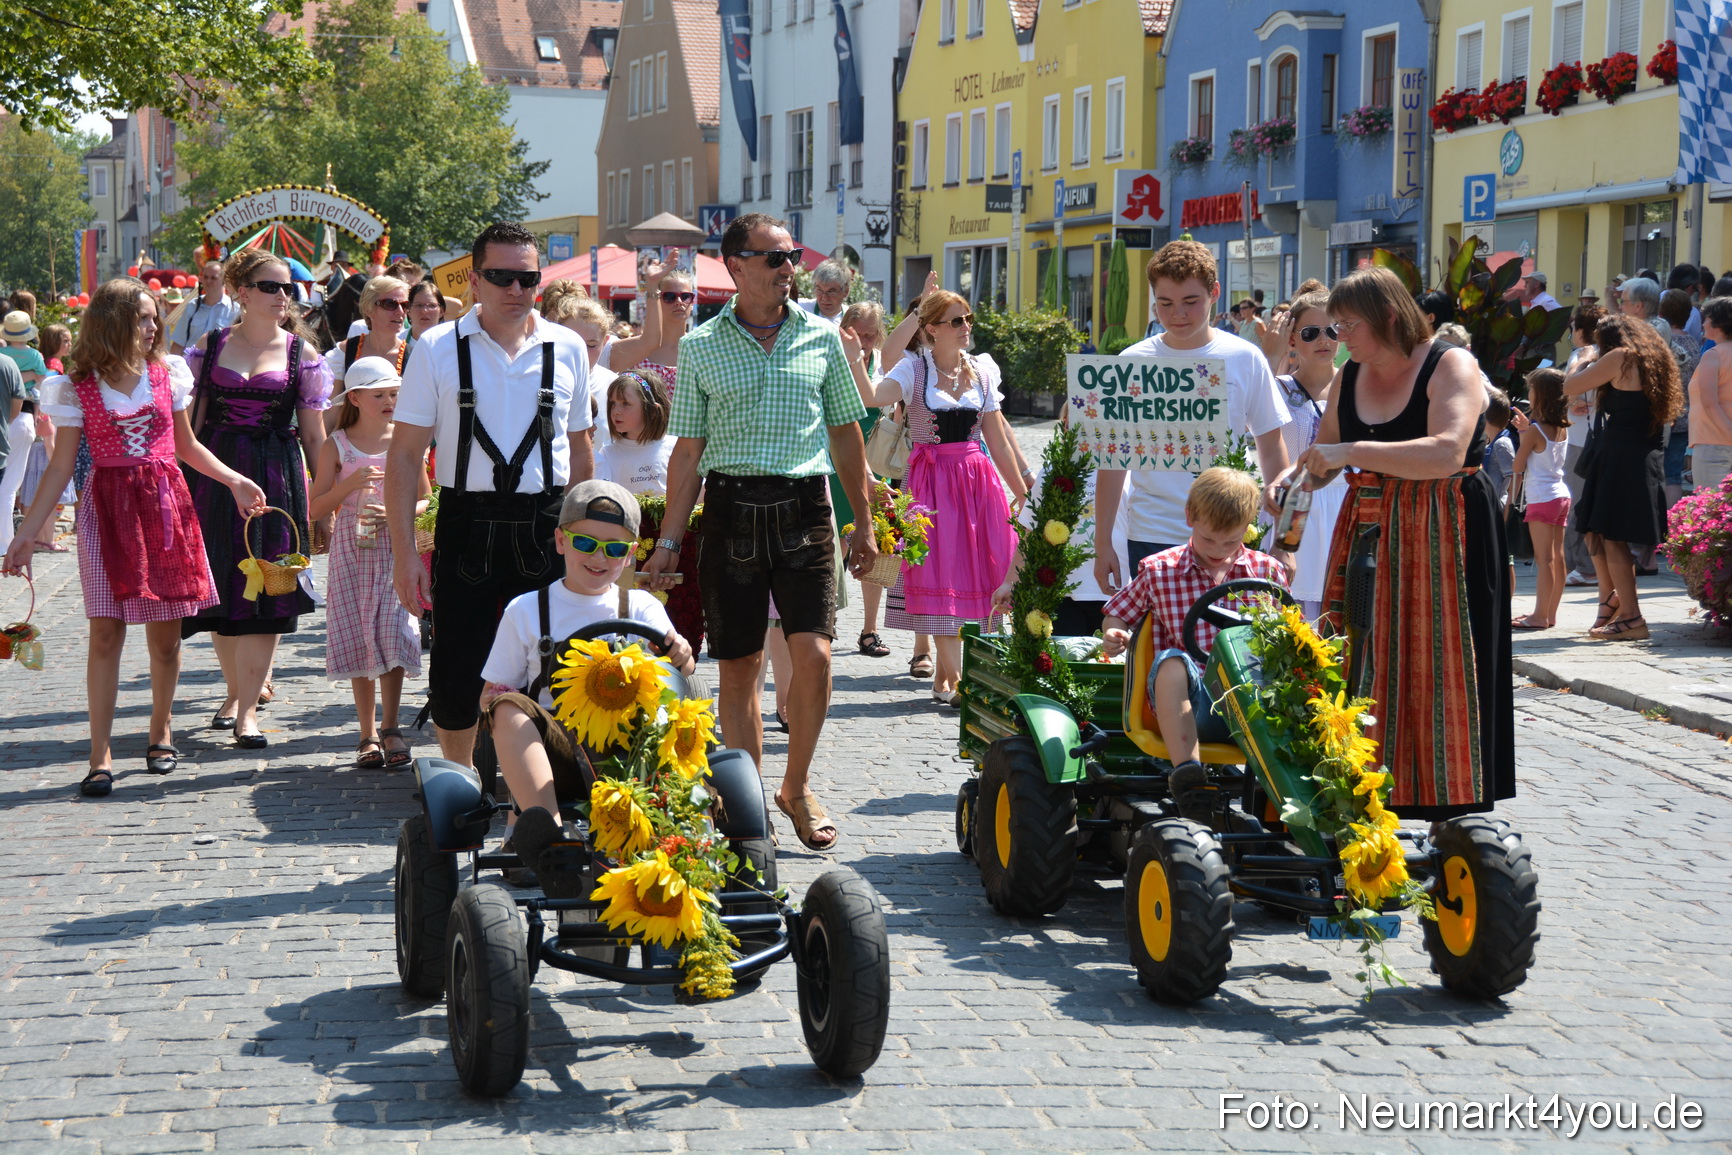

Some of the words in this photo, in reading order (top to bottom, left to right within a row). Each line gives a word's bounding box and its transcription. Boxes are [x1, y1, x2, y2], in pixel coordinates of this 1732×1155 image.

[954, 73, 984, 104] HOTEL
[991, 67, 1025, 93] Lehmeier
[1402, 93, 1420, 187] WITTL
[1013, 157, 1020, 184] P
[988, 201, 1025, 209] TAIF
[1063, 187, 1089, 207] AIFUN
[1470, 180, 1489, 217] P
[216, 195, 277, 234] Richtfest
[290, 193, 376, 238] Bürgerhaus
[949, 216, 991, 236] Restaurant
[446, 266, 471, 288] Pöll
[1099, 396, 1221, 423] RITTERSHOF
